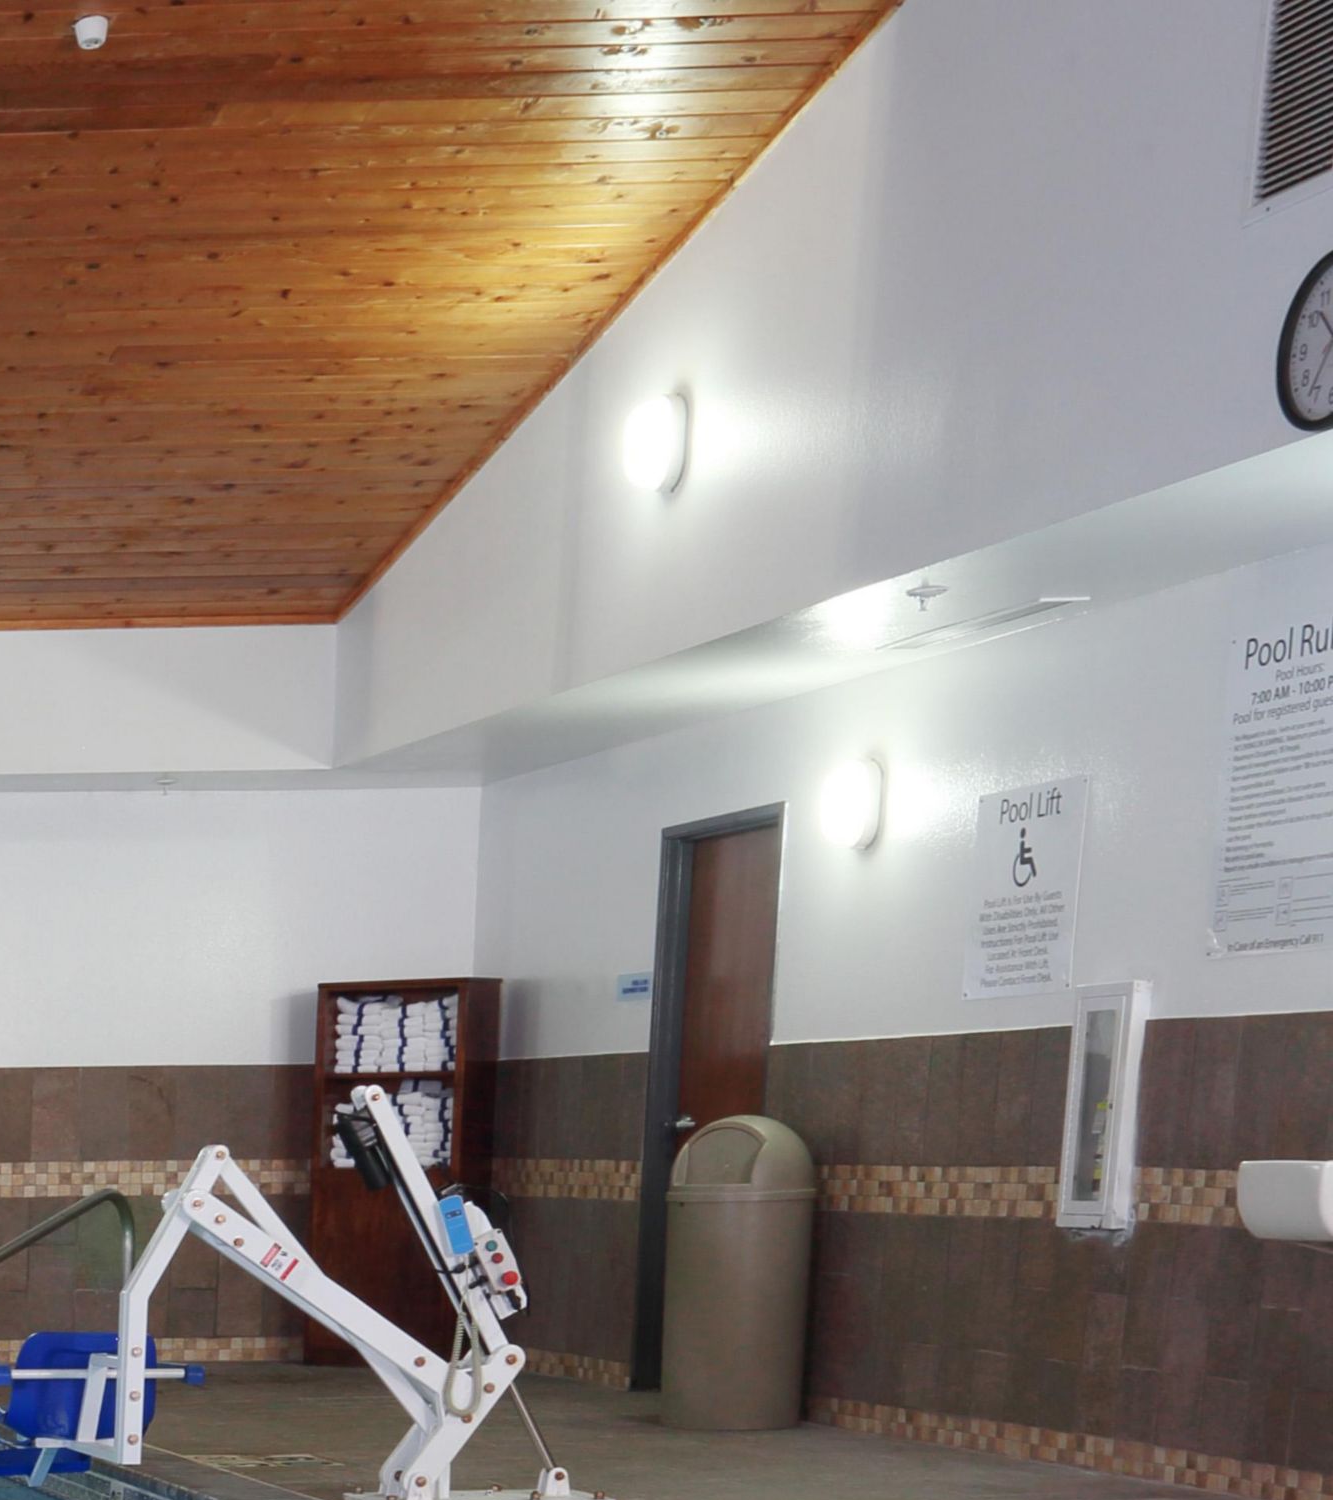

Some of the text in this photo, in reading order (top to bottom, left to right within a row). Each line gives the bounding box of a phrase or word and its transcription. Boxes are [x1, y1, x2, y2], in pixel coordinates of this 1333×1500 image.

[1308, 311, 1320, 328] 10
[1299, 343, 1308, 361] 9
[1301, 369, 1310, 387] 8
[1244, 626, 1294, 670] Pool
[1275, 667, 1294, 682] Pool
[1251, 690, 1272, 705] 7:00
[1272, 685, 1290, 701] AM
[1299, 678, 1326, 695] 10:00
[999, 787, 1062, 825] Pool Lift
